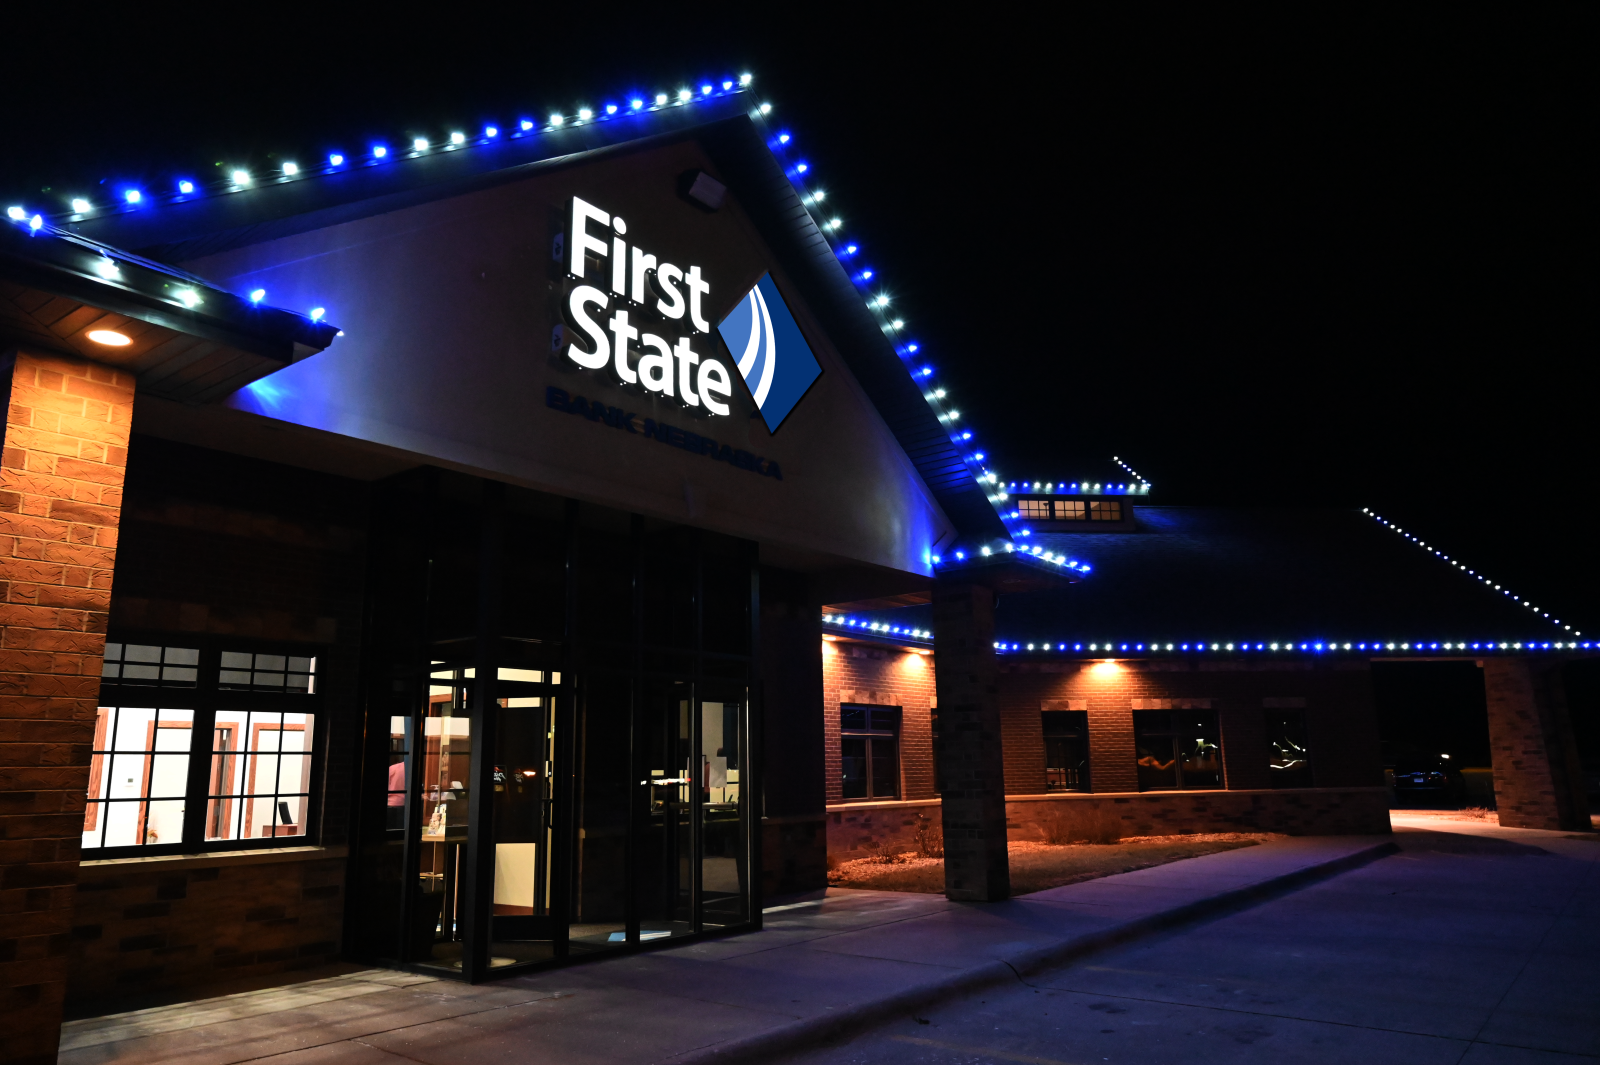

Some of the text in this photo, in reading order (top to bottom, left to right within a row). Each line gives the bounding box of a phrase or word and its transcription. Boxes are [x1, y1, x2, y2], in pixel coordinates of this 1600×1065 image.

[570, 196, 710, 333] First
[568, 285, 732, 416] State
[546, 386, 783, 481] BANK NEBRASKA
